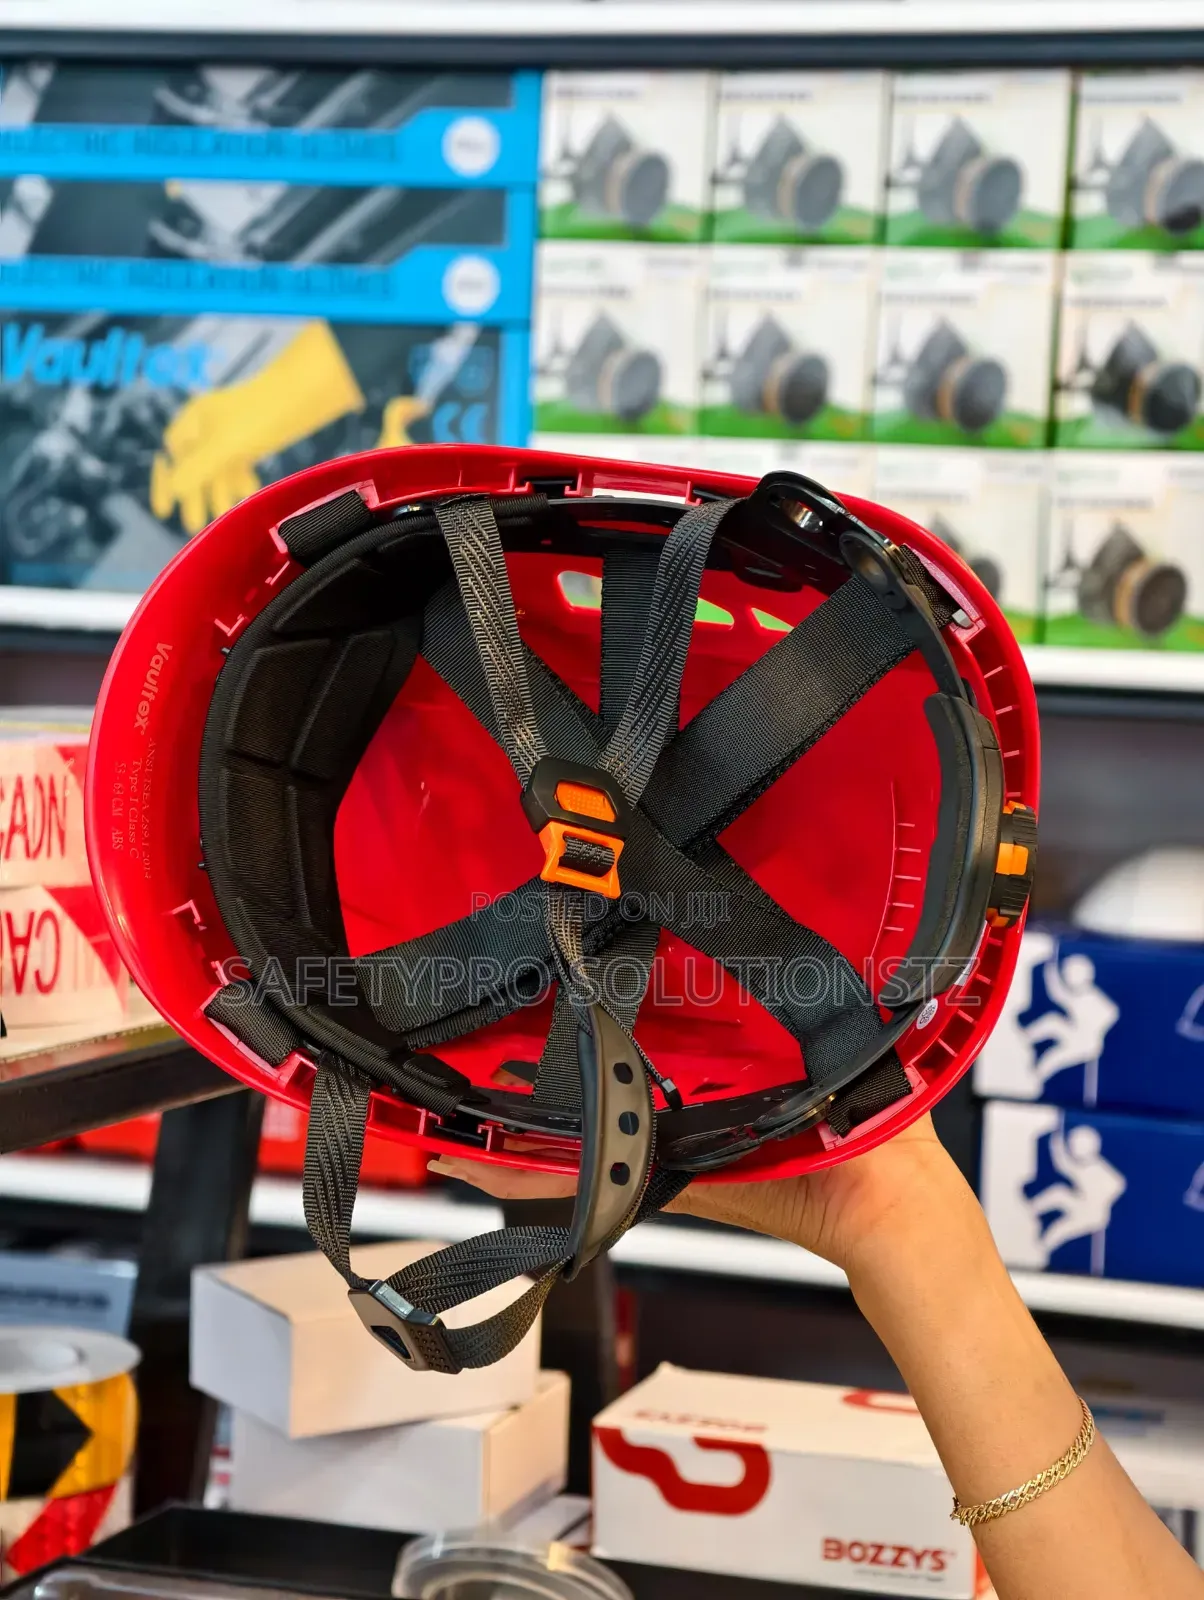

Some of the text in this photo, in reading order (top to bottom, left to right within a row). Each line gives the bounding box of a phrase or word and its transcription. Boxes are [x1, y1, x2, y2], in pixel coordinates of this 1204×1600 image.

[134, 642, 173, 730] Vaultex
[128, 758, 143, 793] Type
[112, 826, 124, 851] ABS
[128, 807, 139, 844] Class
[129, 847, 140, 860] C
[0, 909, 61, 996] CA
[823, 1537, 946, 1572] BOZZYS
